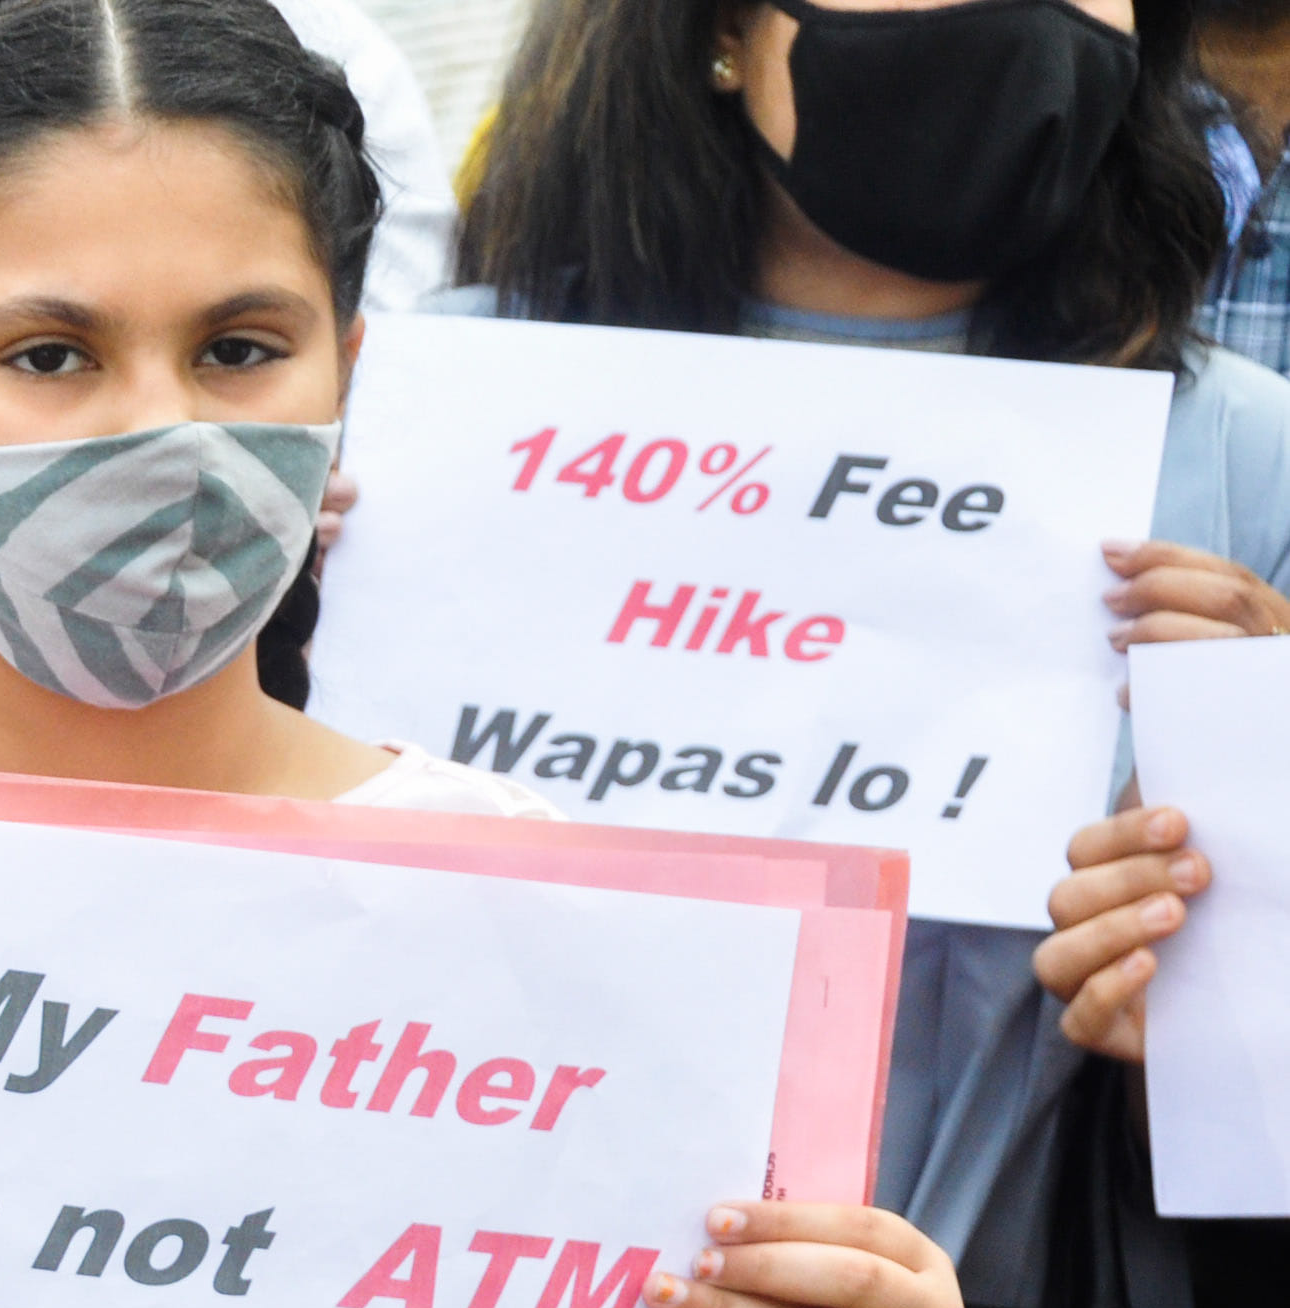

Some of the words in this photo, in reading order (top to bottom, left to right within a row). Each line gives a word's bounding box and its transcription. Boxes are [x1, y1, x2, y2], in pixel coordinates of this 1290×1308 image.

[510, 428, 771, 515] 140%
[808, 454, 1005, 533] Fee
[606, 580, 846, 662] Hike
[450, 705, 783, 801] Wapas
[812, 744, 910, 811] lo
[941, 757, 988, 819] !
[141, 992, 607, 1132] Father
[31, 1204, 276, 1296] not
